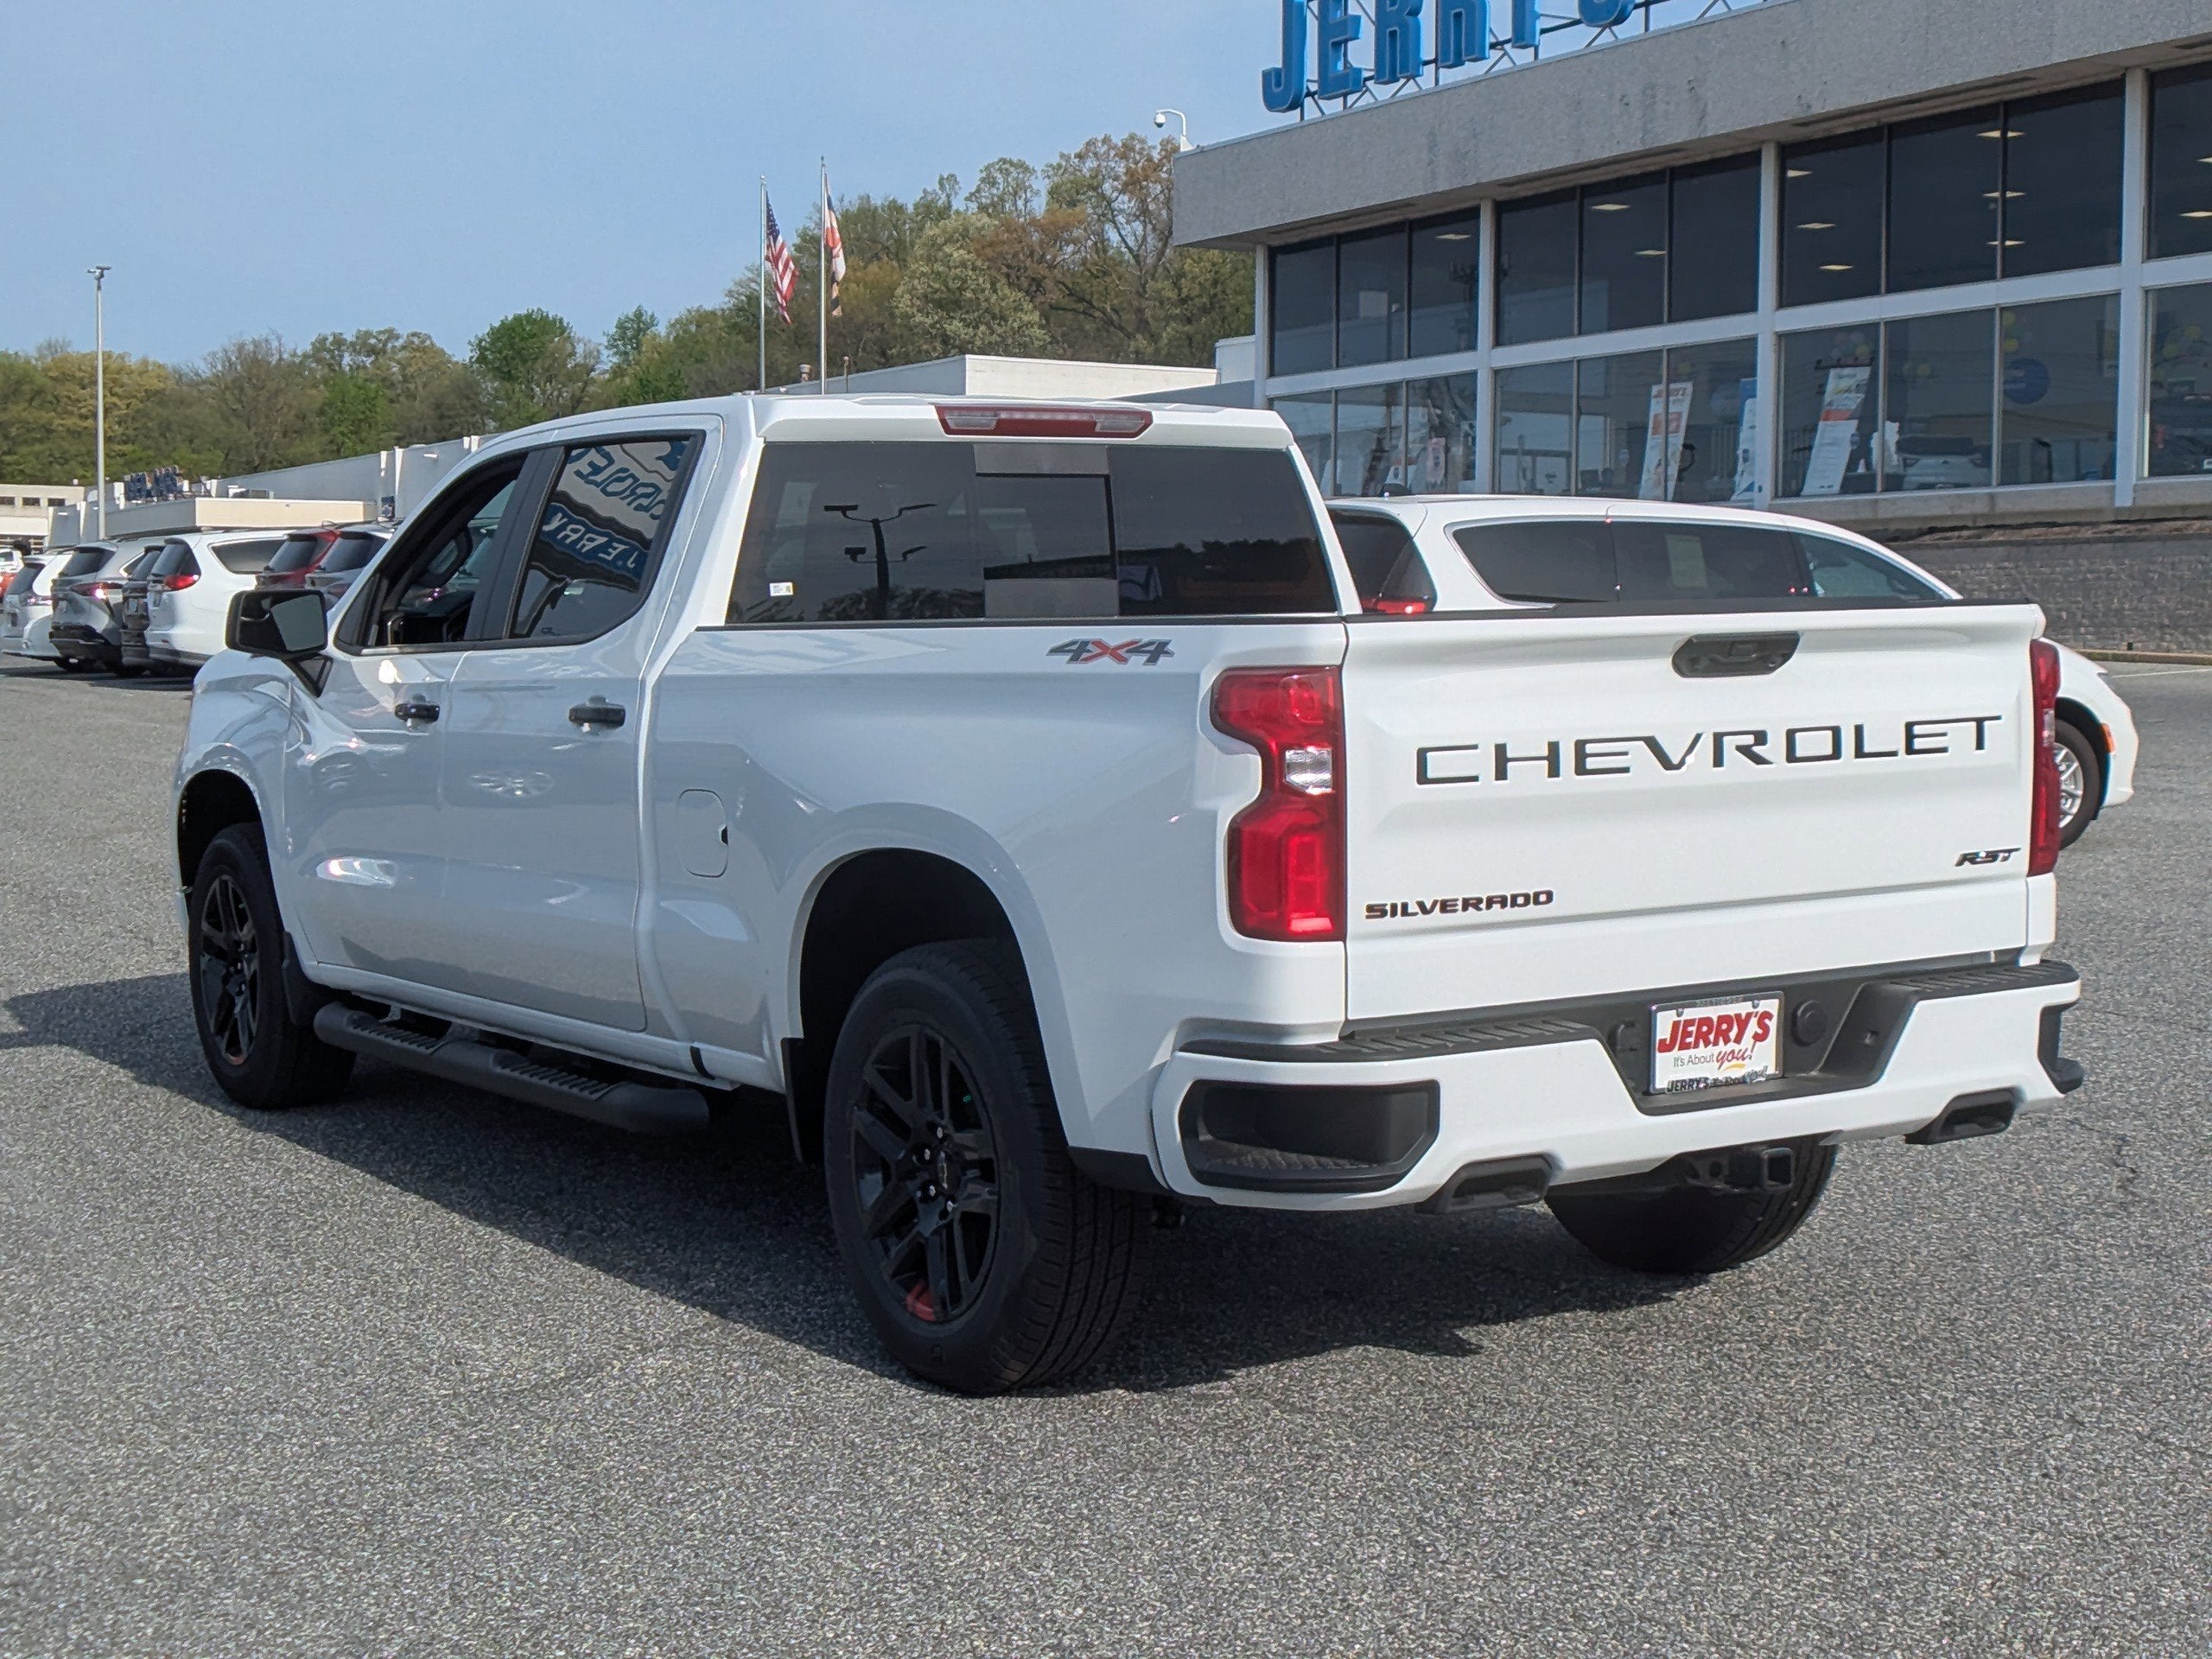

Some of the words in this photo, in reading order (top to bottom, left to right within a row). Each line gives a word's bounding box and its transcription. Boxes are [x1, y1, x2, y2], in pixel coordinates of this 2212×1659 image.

[1415, 715, 2003, 785] CHEVROLET
[1954, 846, 2022, 868] RST
[1364, 888, 1554, 919] SILVERADO
[1656, 1010, 1775, 1054] JERRY'S
[1673, 1056, 1686, 1068] It's
[1687, 1053, 1715, 1066] About
[1715, 1040, 1757, 1071] you!
